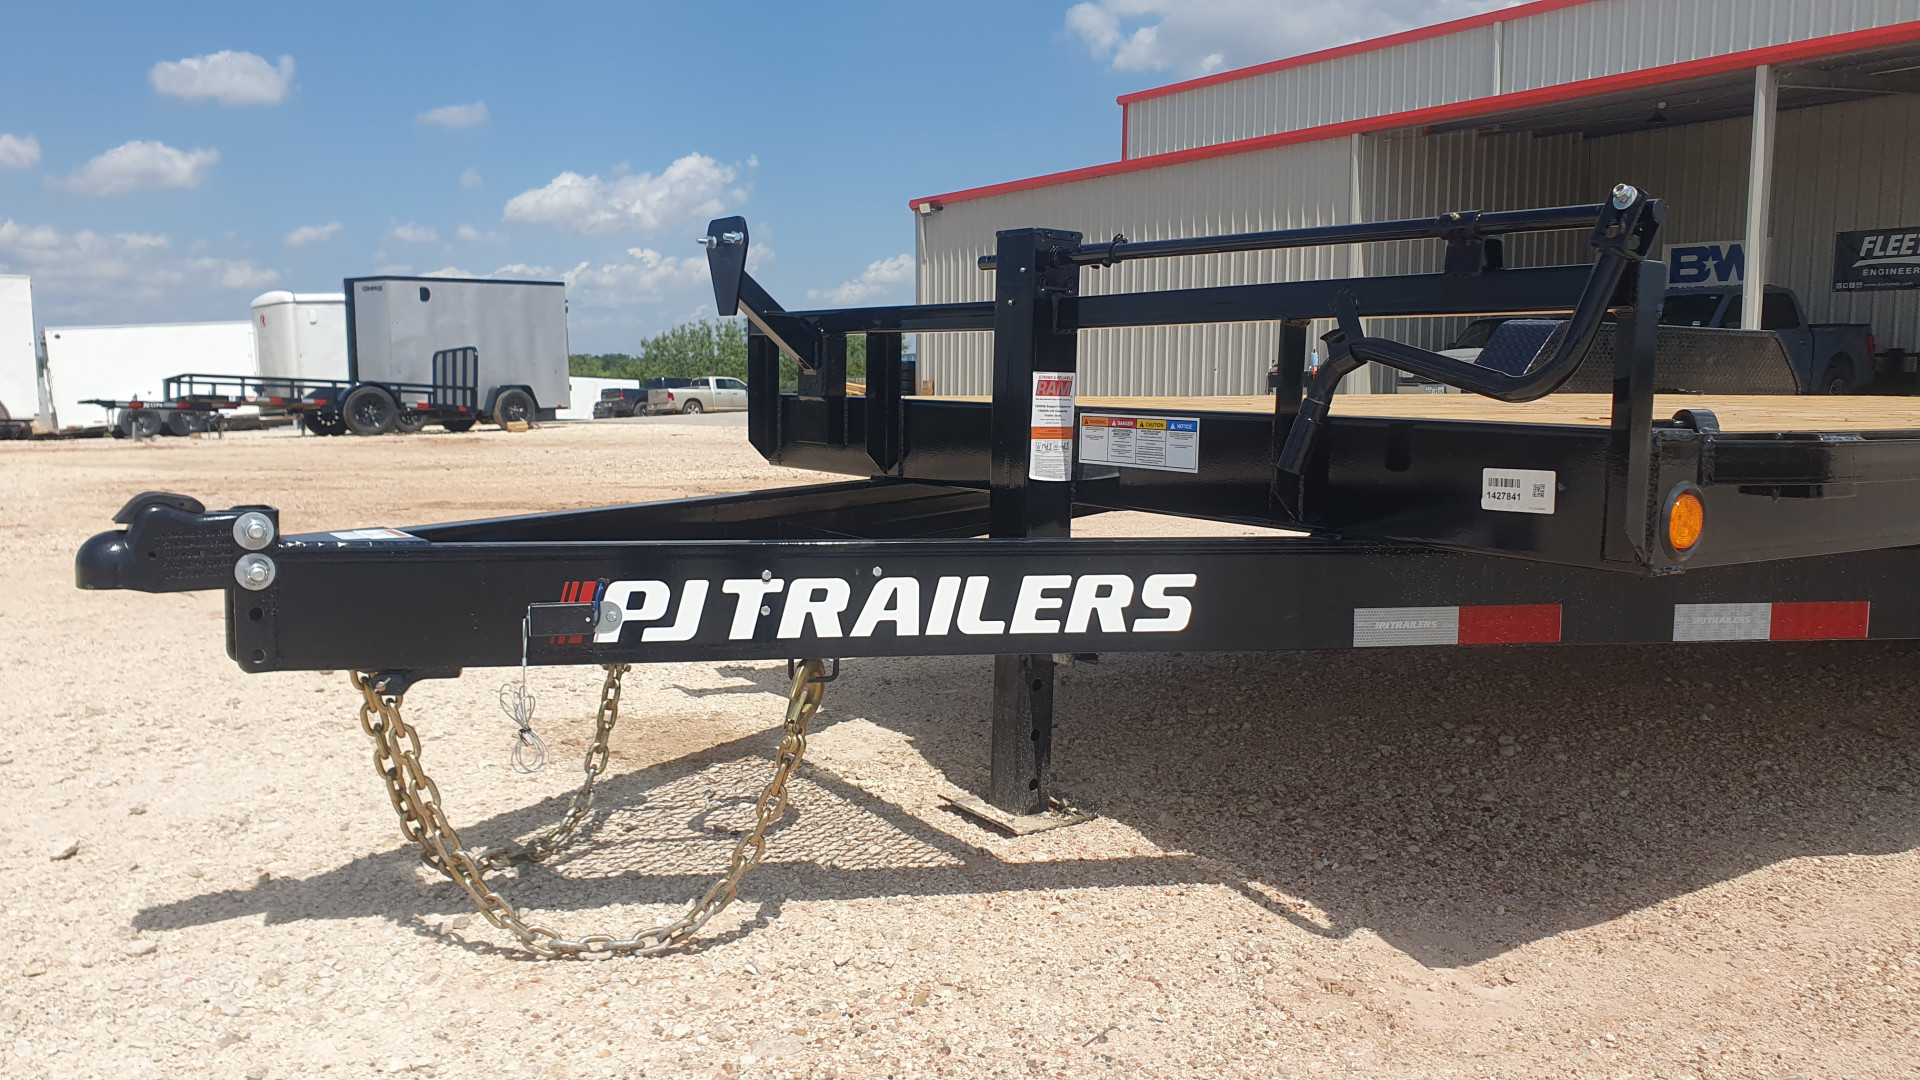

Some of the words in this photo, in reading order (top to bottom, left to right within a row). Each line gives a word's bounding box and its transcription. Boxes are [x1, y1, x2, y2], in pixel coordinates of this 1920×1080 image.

[1860, 233, 1920, 257] FLEE
[1037, 381, 1071, 395] RAM
[1486, 491, 1521, 501] 1427841
[593, 579, 710, 643] PJ
[722, 573, 1197, 640] TRAILERS
